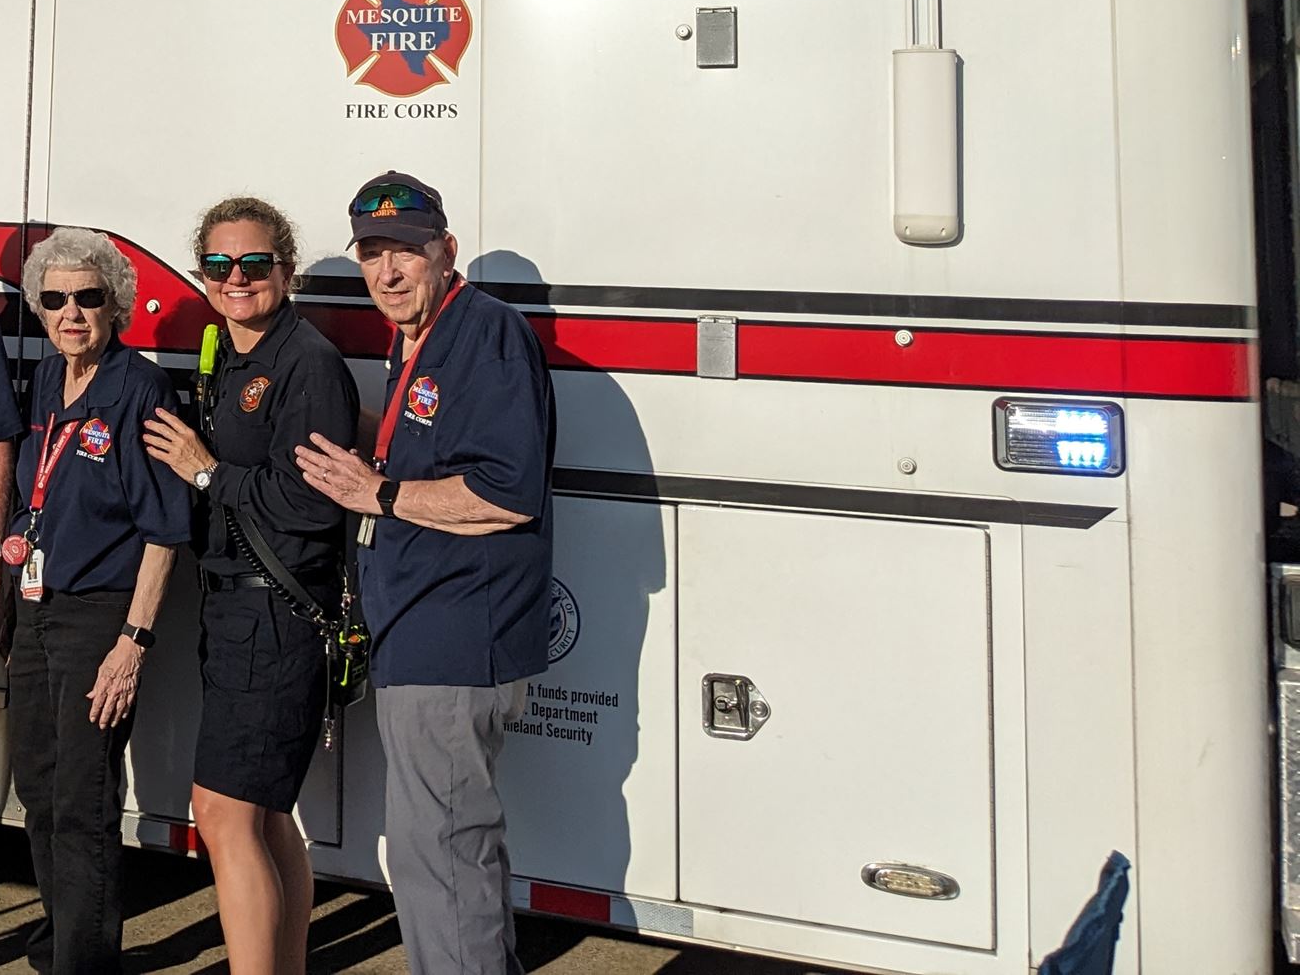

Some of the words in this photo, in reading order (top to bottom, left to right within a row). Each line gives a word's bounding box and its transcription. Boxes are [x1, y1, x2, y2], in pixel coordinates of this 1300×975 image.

[346, 6, 462, 26] MESQUITE
[370, 31, 436, 51] FIRE
[345, 104, 389, 118] FIRE
[394, 104, 458, 118] CORPS
[371, 208, 397, 217] CORPS
[87, 436, 104, 445] FIRE
[548, 627, 575, 659] CURITY
[538, 684, 568, 701] funds
[571, 690, 619, 707] provided
[531, 702, 598, 724] Department
[503, 720, 543, 736] meland
[546, 722, 593, 746] Security
